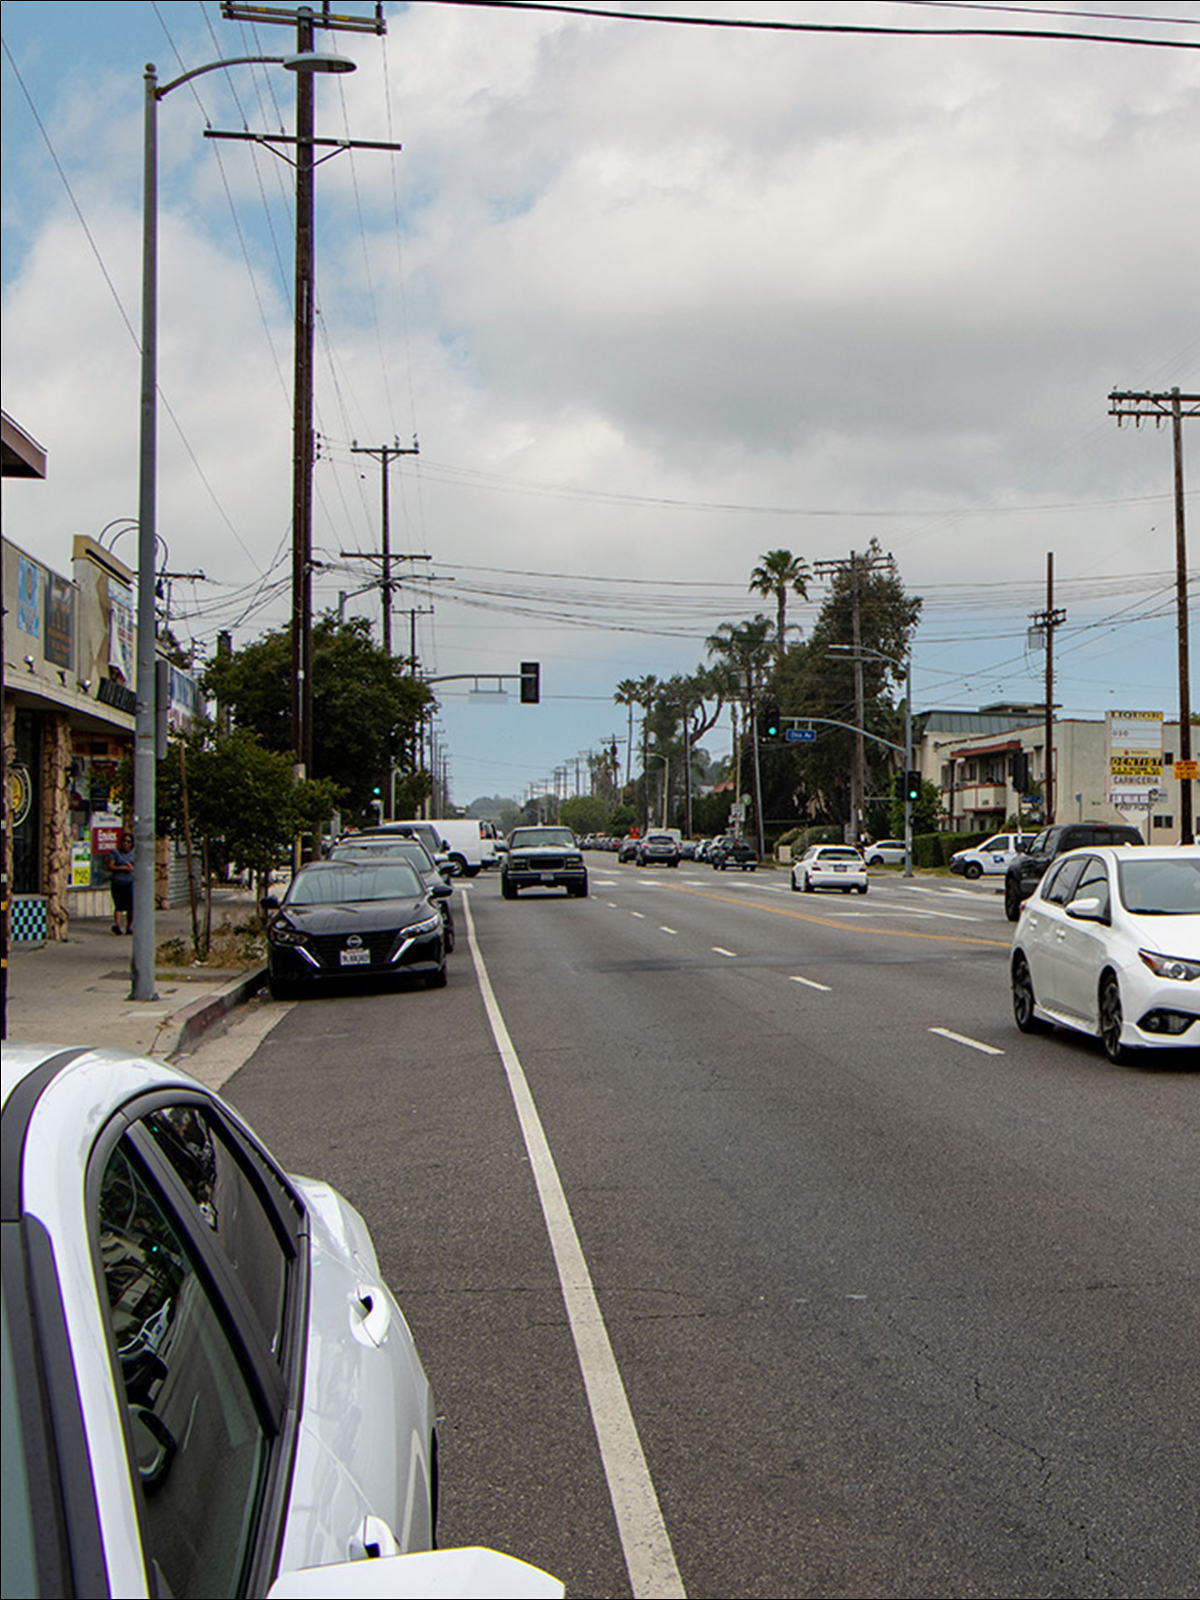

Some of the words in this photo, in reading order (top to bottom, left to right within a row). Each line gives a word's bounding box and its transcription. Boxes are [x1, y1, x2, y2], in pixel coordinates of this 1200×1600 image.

[1110, 710, 1160, 718] LIQUOR
[1111, 757, 1161, 766] DENTIST
[1113, 776, 1159, 784] CARNICERIA
